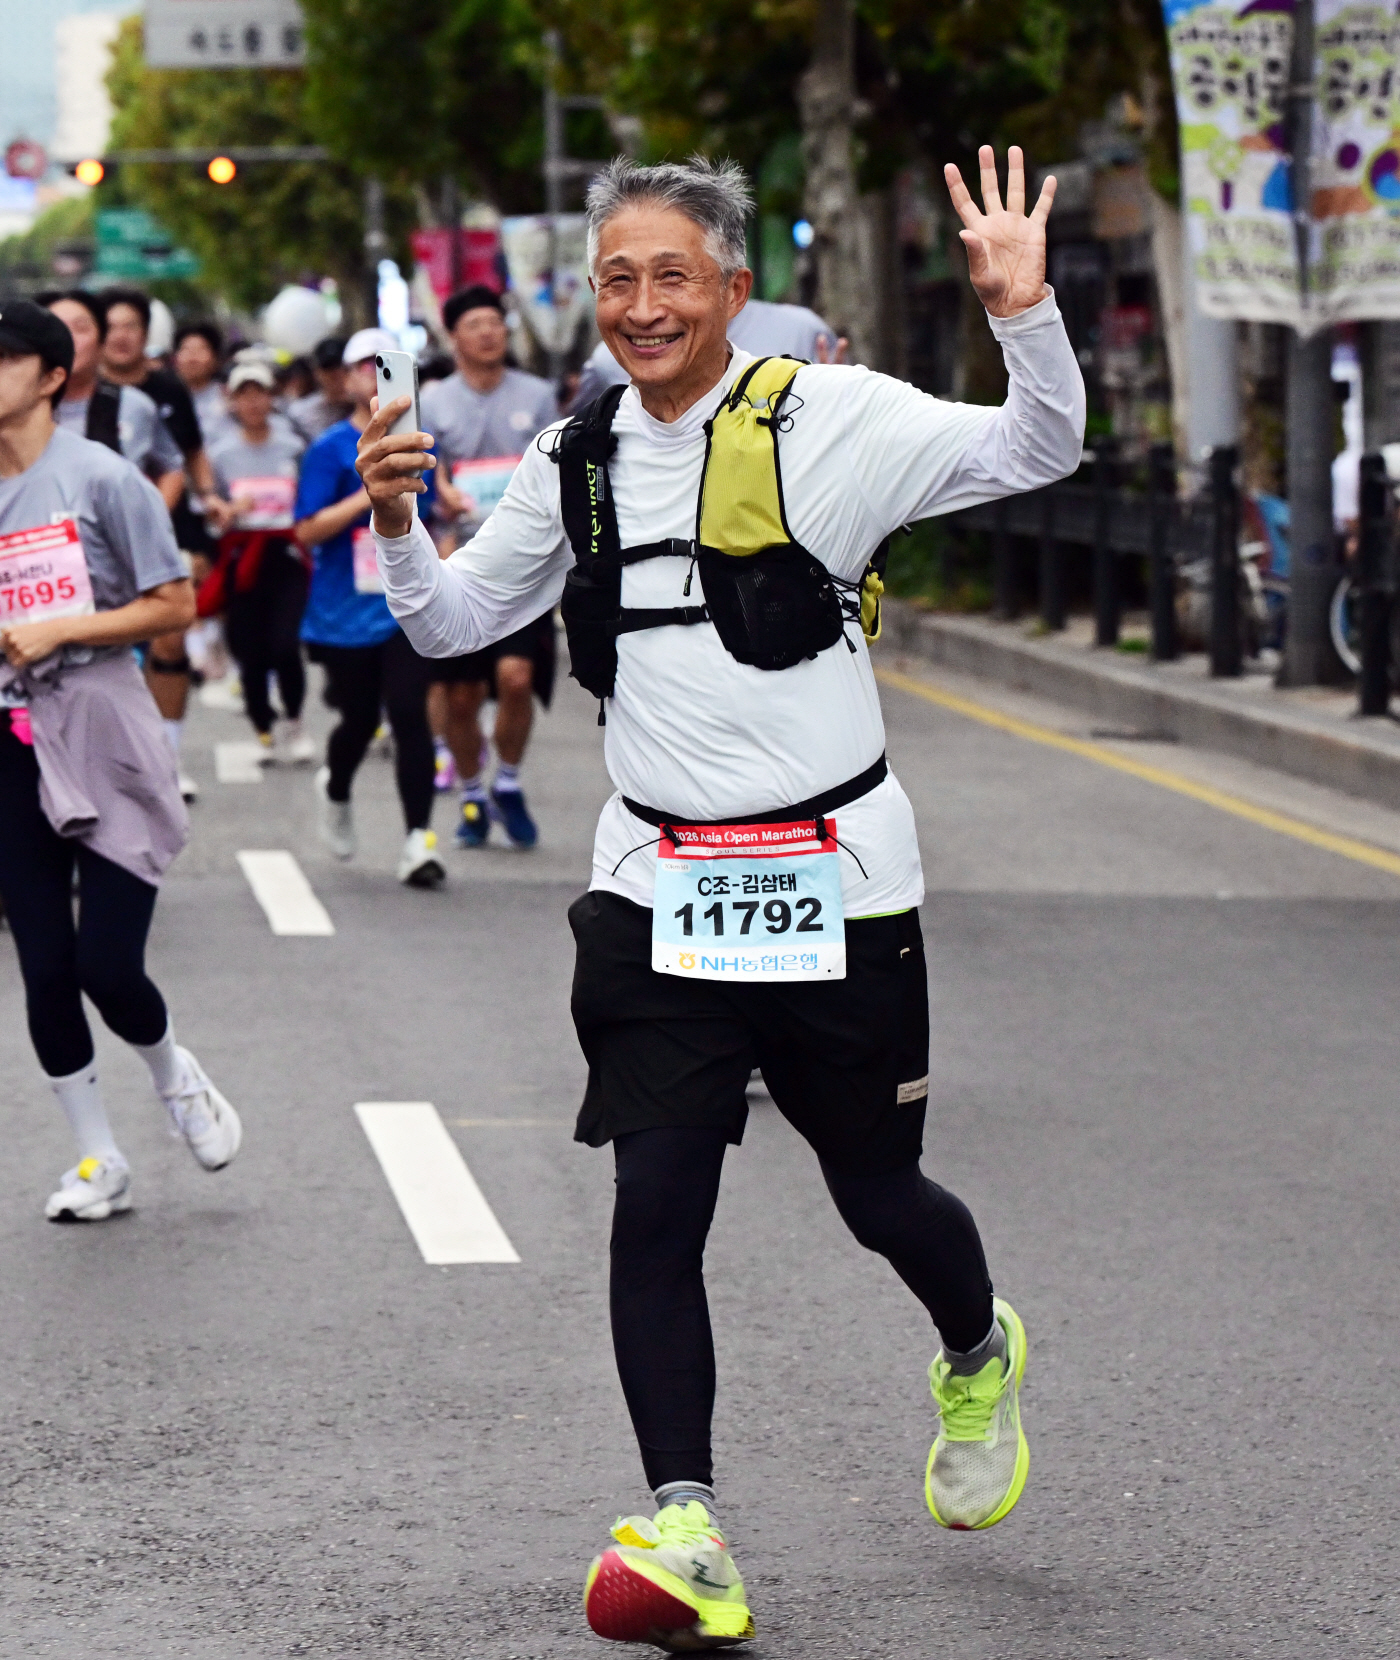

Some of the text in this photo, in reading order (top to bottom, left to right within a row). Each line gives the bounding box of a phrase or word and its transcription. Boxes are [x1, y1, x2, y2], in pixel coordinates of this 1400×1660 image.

[0, 575, 76, 614] 7695
[700, 831, 722, 844] Asia
[706, 846, 780, 855] SEOUL SERIES
[697, 873, 797, 896] C조-김삼태
[674, 897, 824, 937] 11792
[701, 953, 818, 972] NH농협은행
